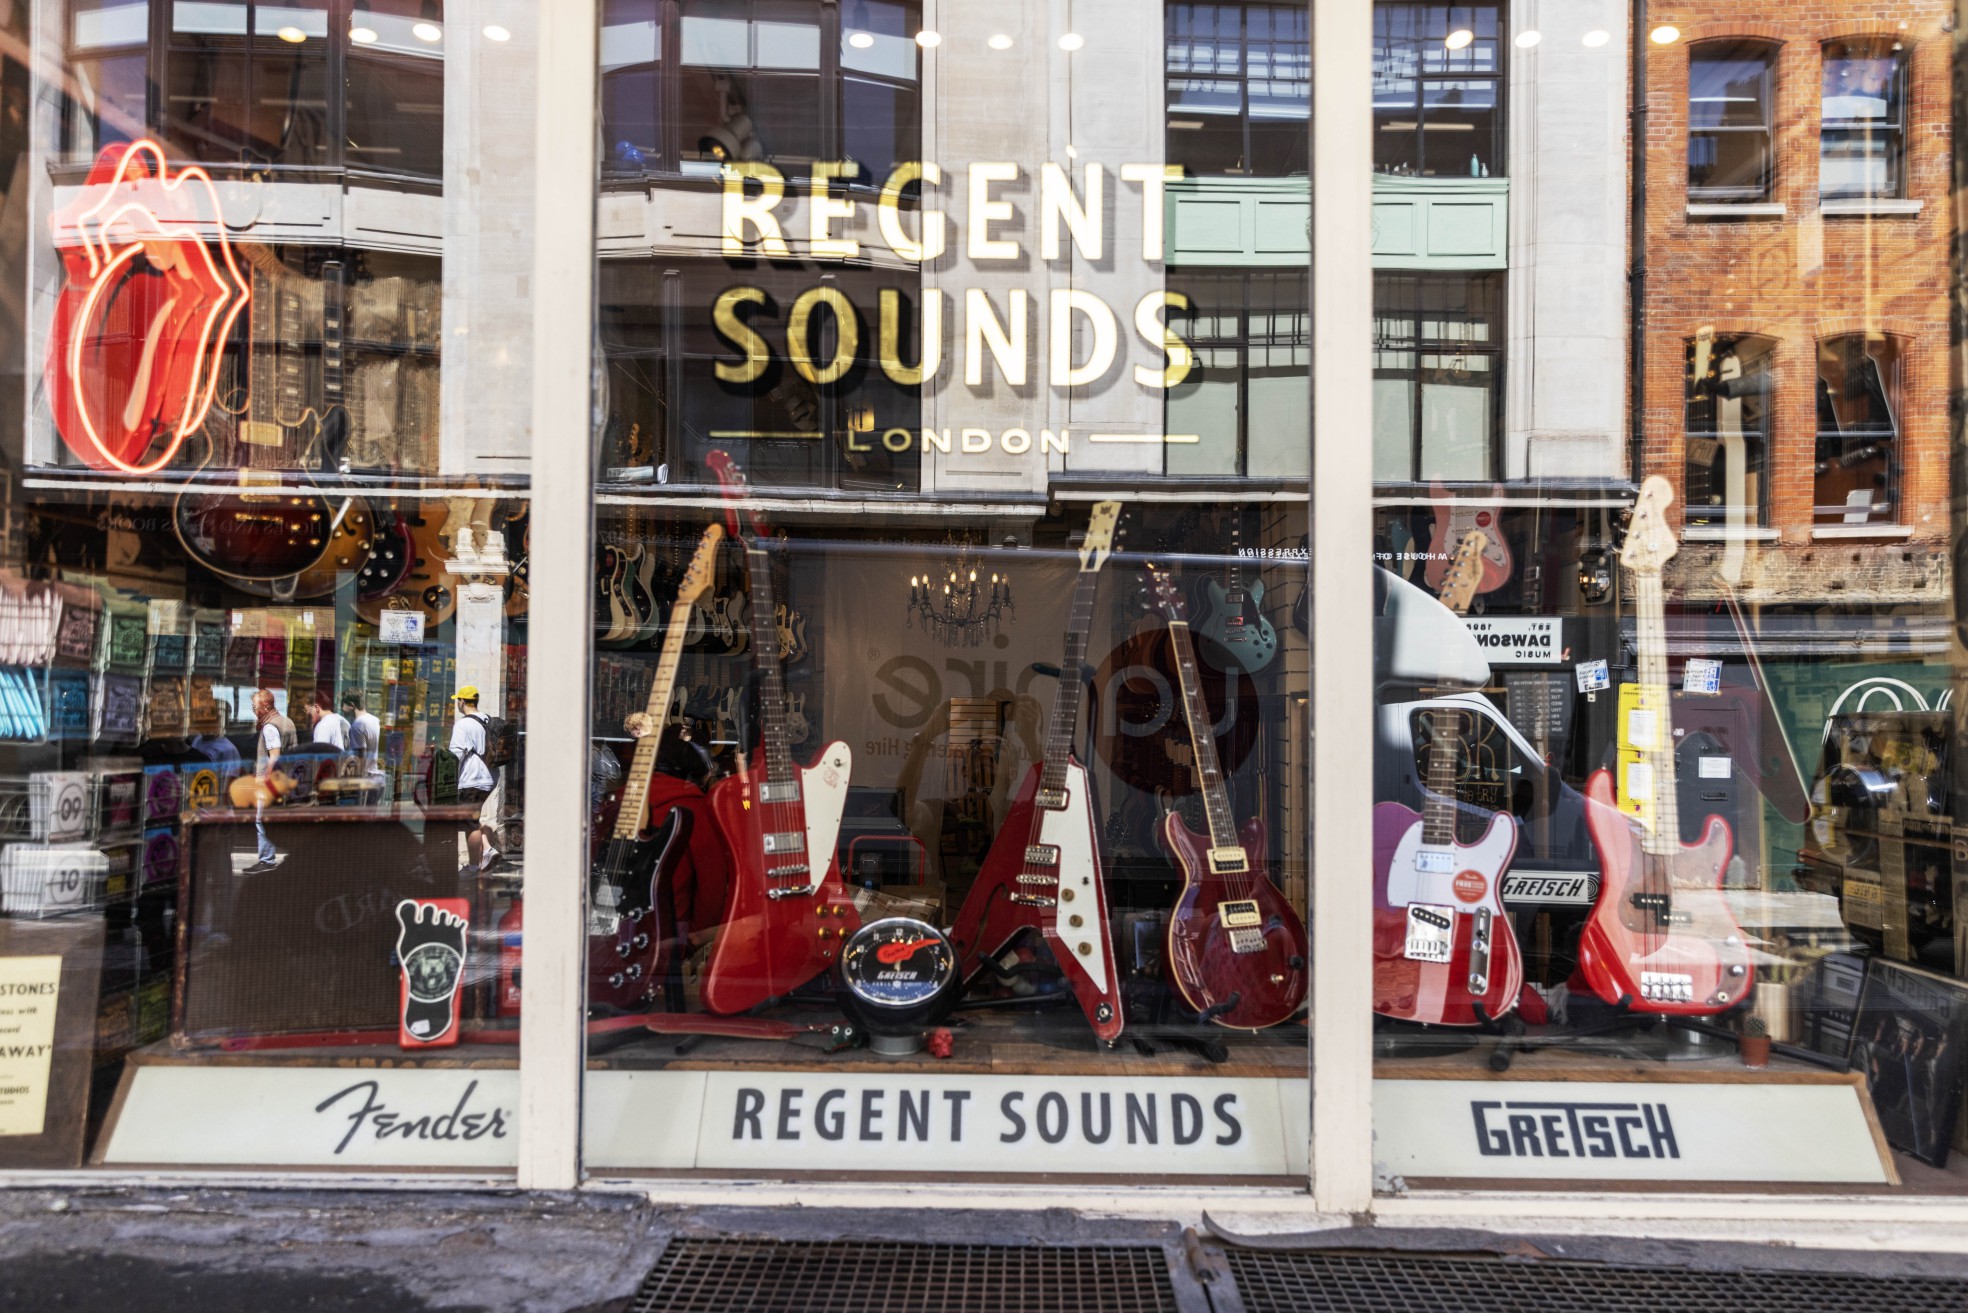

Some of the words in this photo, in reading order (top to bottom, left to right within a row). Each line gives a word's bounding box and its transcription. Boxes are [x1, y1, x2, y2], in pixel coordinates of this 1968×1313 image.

[721, 161, 1186, 261] REGENT
[712, 286, 1194, 388] SOUNDS
[847, 427, 1071, 454] LONDON
[61, 797, 82, 822] 09
[59, 869, 81, 893] 10
[1502, 877, 1585, 897] GRETSCH
[0, 983, 56, 995] STONES
[315, 1079, 510, 1154] Fender
[732, 1088, 971, 1142] REGENT
[999, 1090, 1243, 1146] SOUNDS
[1469, 1100, 1681, 1159] GRETSCH
